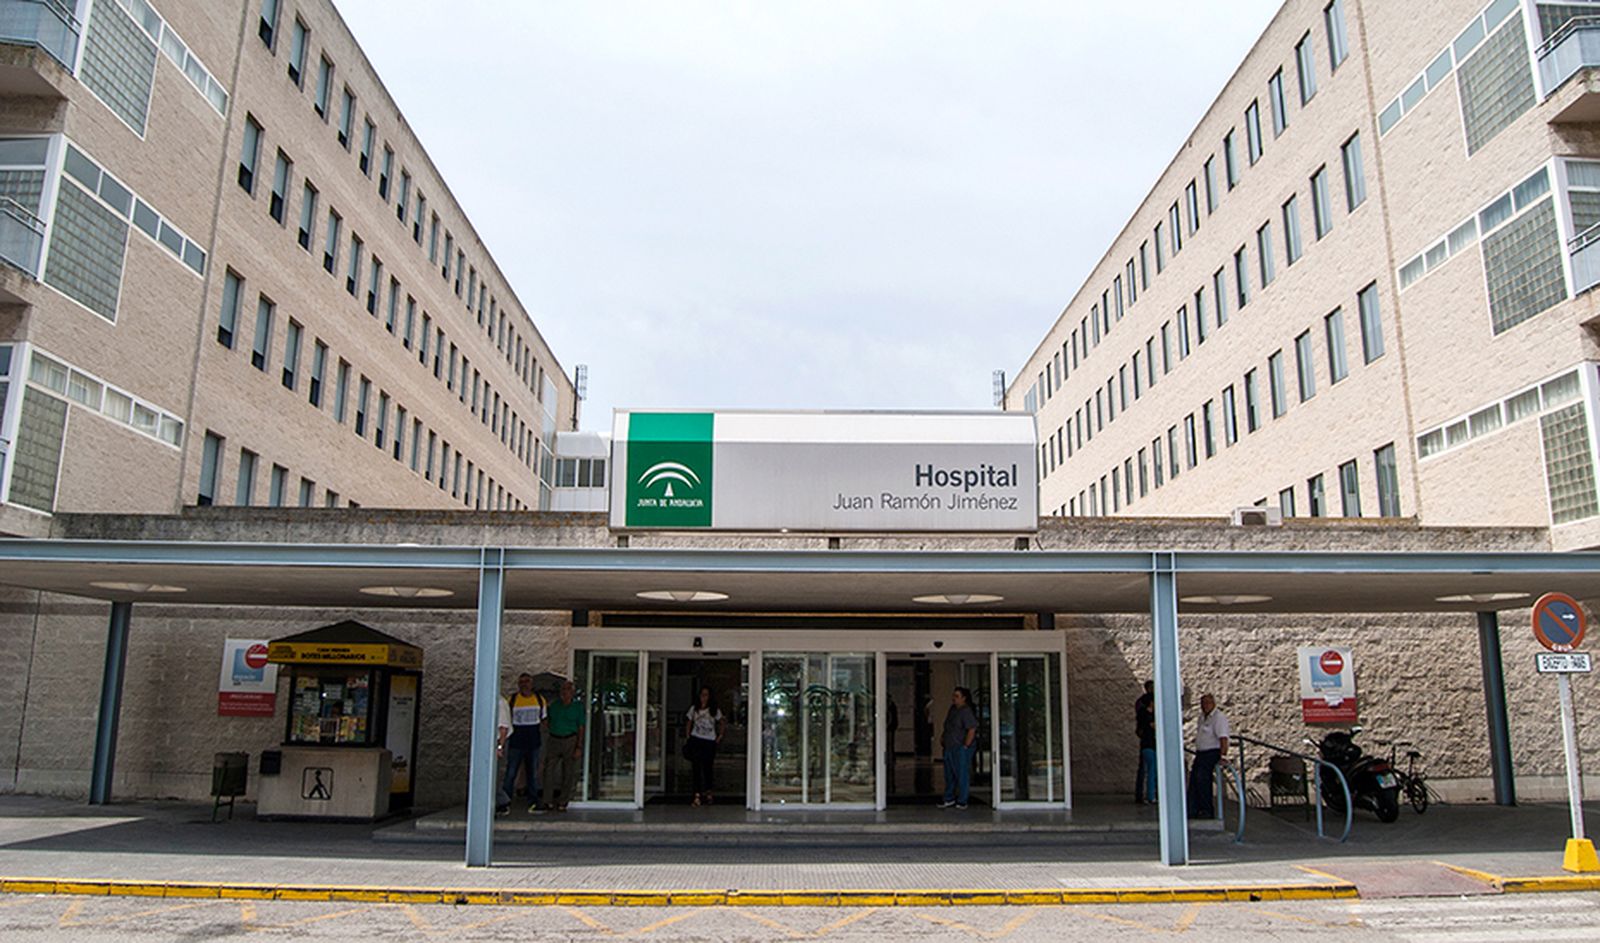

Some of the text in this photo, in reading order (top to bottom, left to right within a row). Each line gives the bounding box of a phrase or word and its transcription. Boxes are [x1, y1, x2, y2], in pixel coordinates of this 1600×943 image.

[915, 464, 1018, 493] Hospital
[636, 498, 657, 507] JUNTA
[659, 498, 668, 507] DE
[832, 493, 1018, 510] Juan Ramón Jiménez
